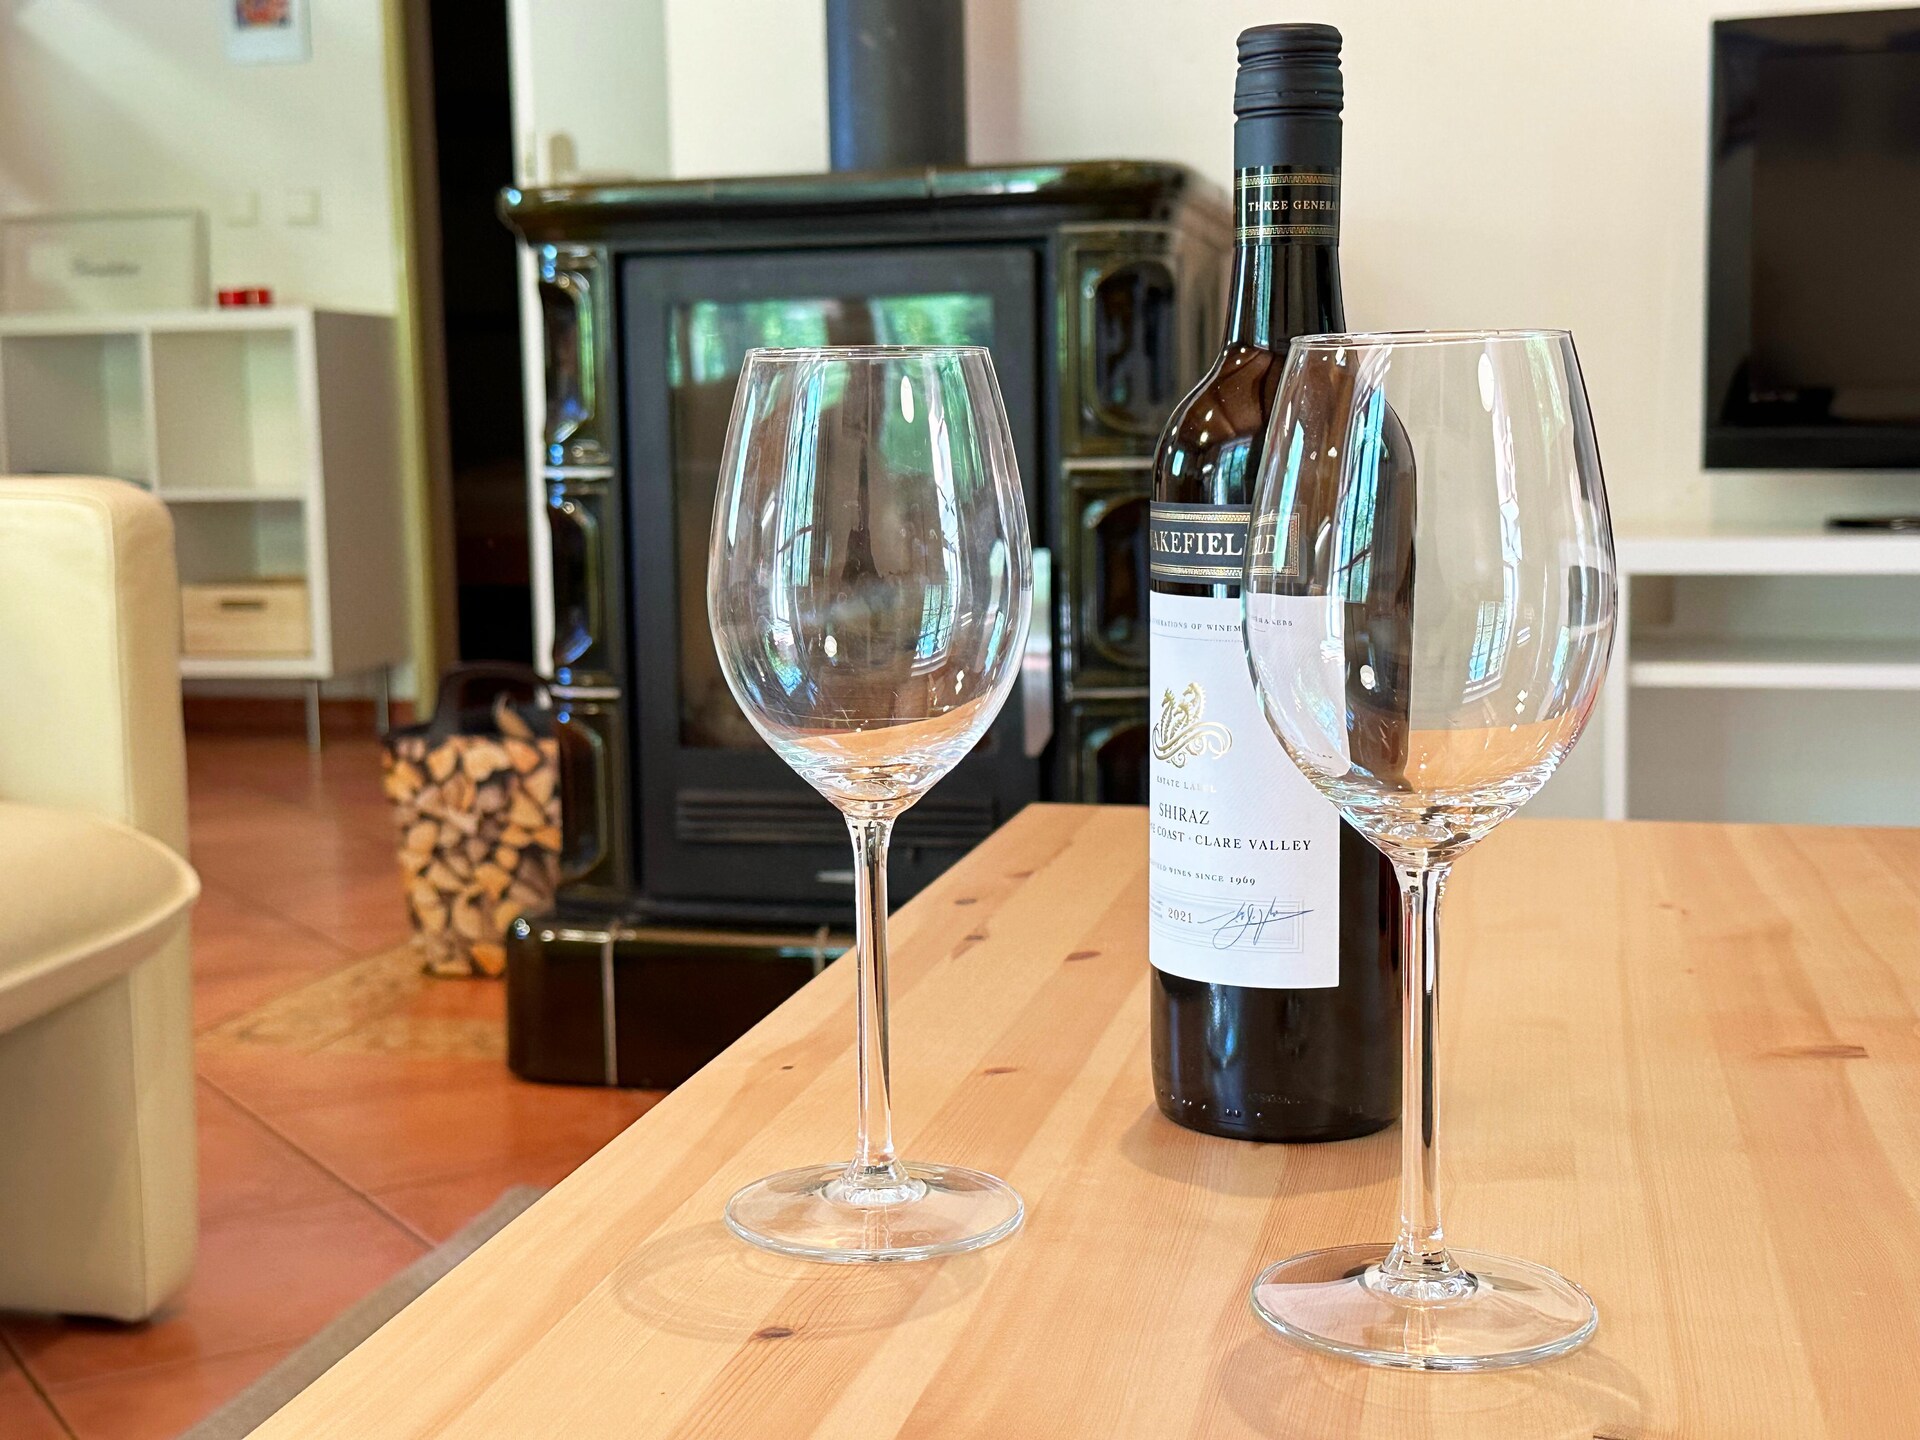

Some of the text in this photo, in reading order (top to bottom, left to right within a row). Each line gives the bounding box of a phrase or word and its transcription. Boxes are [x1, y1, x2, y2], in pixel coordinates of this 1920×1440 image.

[1248, 200, 1289, 212] THREE
[1190, 622, 1203, 631] OF
[1158, 802, 1210, 825] SHIRAZ
[1156, 825, 1186, 842] COAST
[1194, 834, 1242, 850] CLARE
[1248, 839, 1311, 851] VALLEY
[1168, 866, 1192, 878] WINES
[1195, 872, 1224, 882] SINCE
[1230, 875, 1256, 886] 1969
[1167, 907, 1193, 924] 2021
